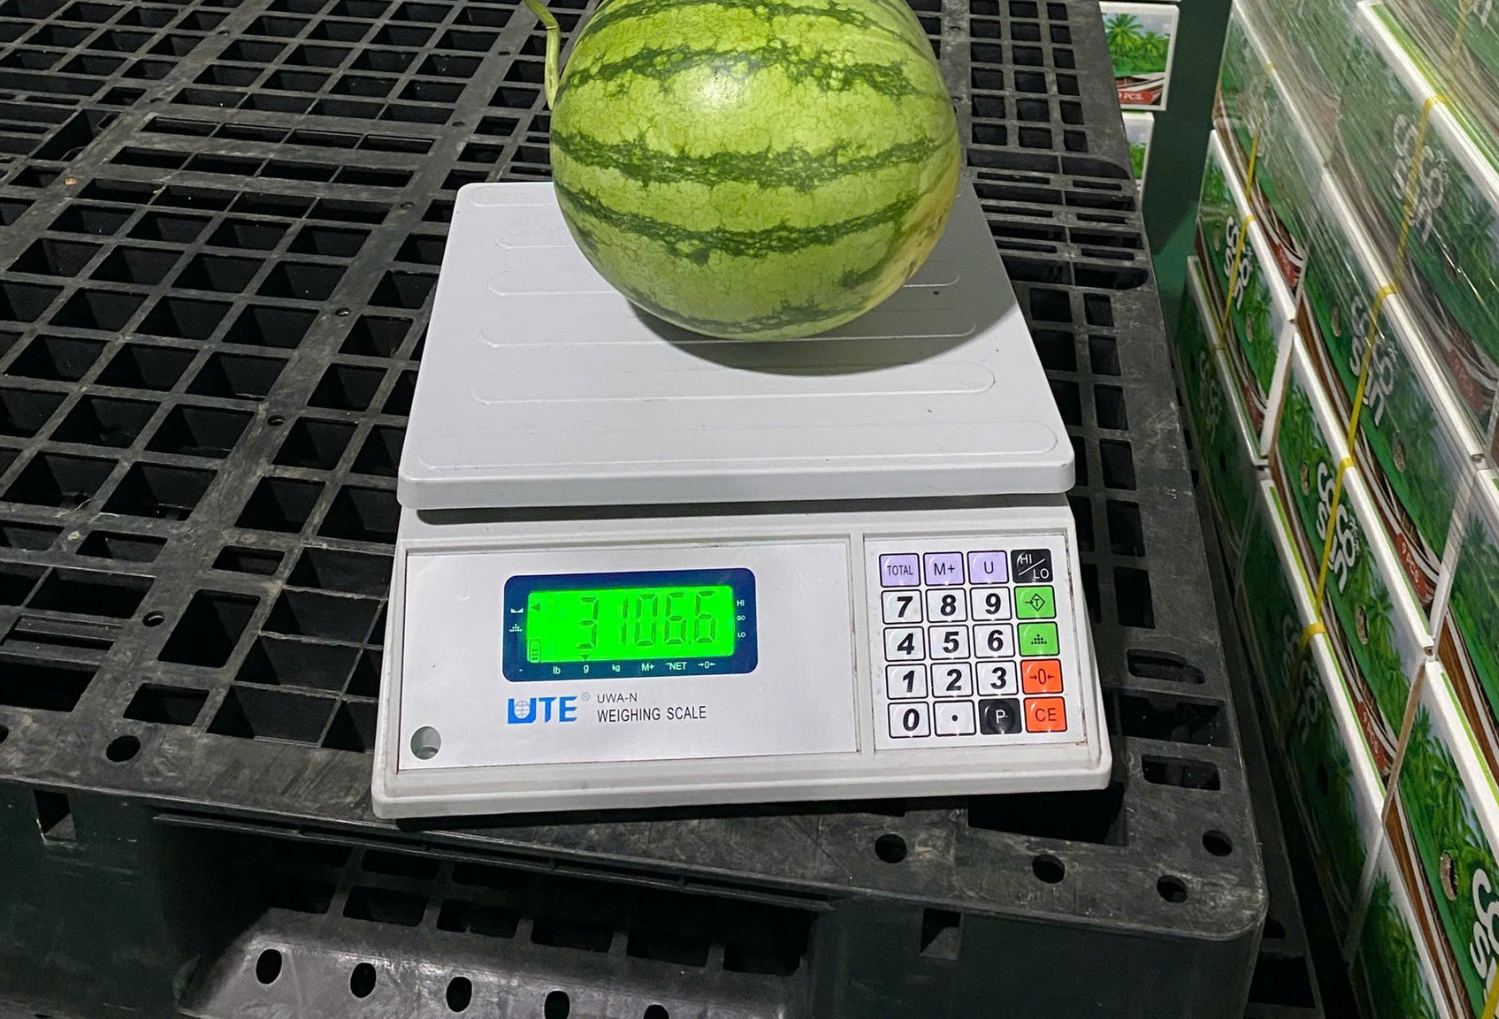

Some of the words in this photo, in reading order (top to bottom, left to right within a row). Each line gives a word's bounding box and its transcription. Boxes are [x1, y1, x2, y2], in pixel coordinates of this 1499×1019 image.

[934, 563, 955, 575] M+
[984, 562, 994, 574] U
[1020, 554, 1032, 564] HI
[888, 565, 913, 575] TOTAL
[1033, 568, 1049, 579] LO
[897, 596, 912, 617] 7
[940, 595, 956, 616] 8
[985, 593, 1001, 614] 9
[897, 633, 914, 654] 4
[943, 632, 959, 653] 5
[988, 630, 1003, 651] 6
[583, 664, 589, 673] g
[612, 664, 620, 672] kg
[642, 663, 654, 671] M+
[991, 667, 1007, 689] 3
[902, 671, 915, 692] 1
[946, 669, 962, 690] 2
[597, 693, 637, 703] UWA-N
[508, 696, 578, 724] UTE
[597, 708, 660, 723] WEIGHING
[667, 706, 707, 720] SCALE
[903, 709, 919, 731] 0
[1035, 708, 1056, 722] CE
